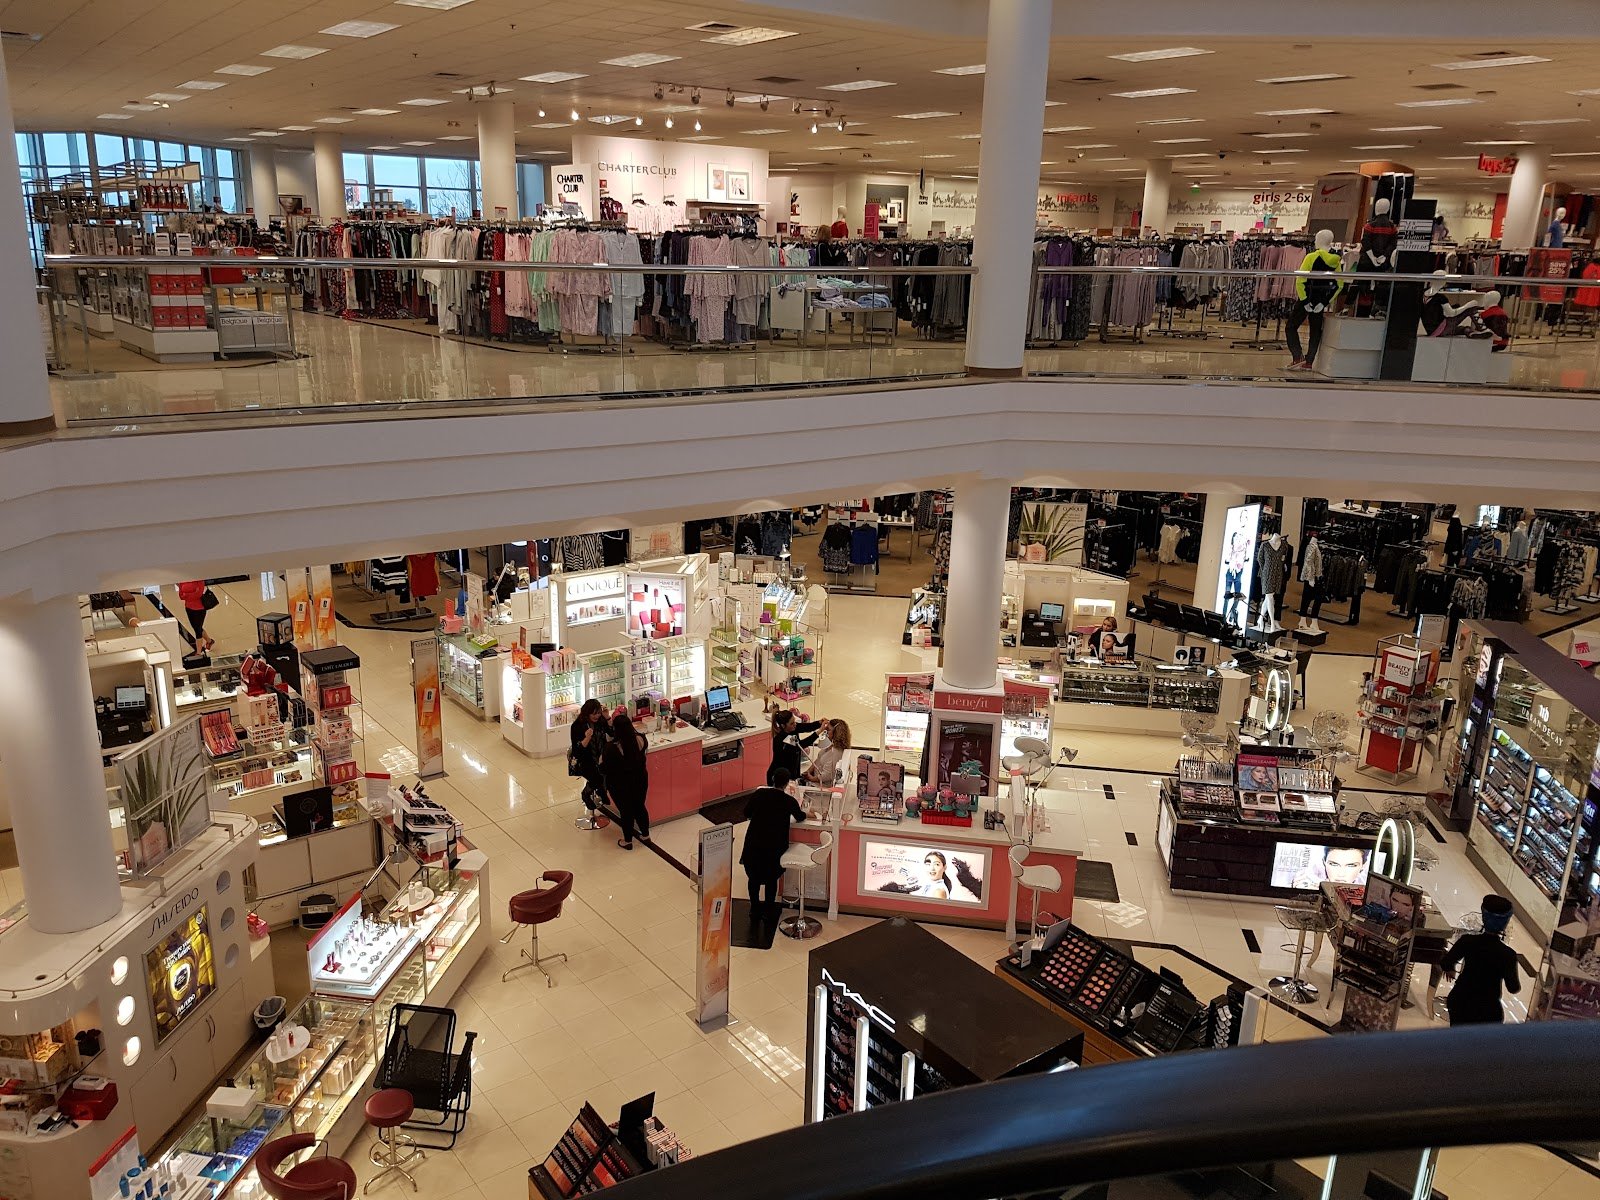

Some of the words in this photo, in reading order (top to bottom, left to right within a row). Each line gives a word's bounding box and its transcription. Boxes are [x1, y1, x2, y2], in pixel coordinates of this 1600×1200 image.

[598, 162, 649, 175] CHARTER
[650, 165, 677, 176] CLUB
[556, 174, 585, 184] CHARTER
[563, 184, 579, 193] CLUB
[1056, 192, 1098, 203] infants
[1253, 191, 1281, 205] girls
[1284, 192, 1311, 203] 2-6x
[568, 577, 622, 595] CLINIQUE
[1388, 661, 1411, 672] BEAUTY
[947, 694, 988, 710] benefit
[1521, 706, 1542, 729] URBAN
[1542, 724, 1564, 747] DECAY
[1301, 846, 1311, 868] HOLIDAY
[147, 887, 199, 939] SHISEIDO
